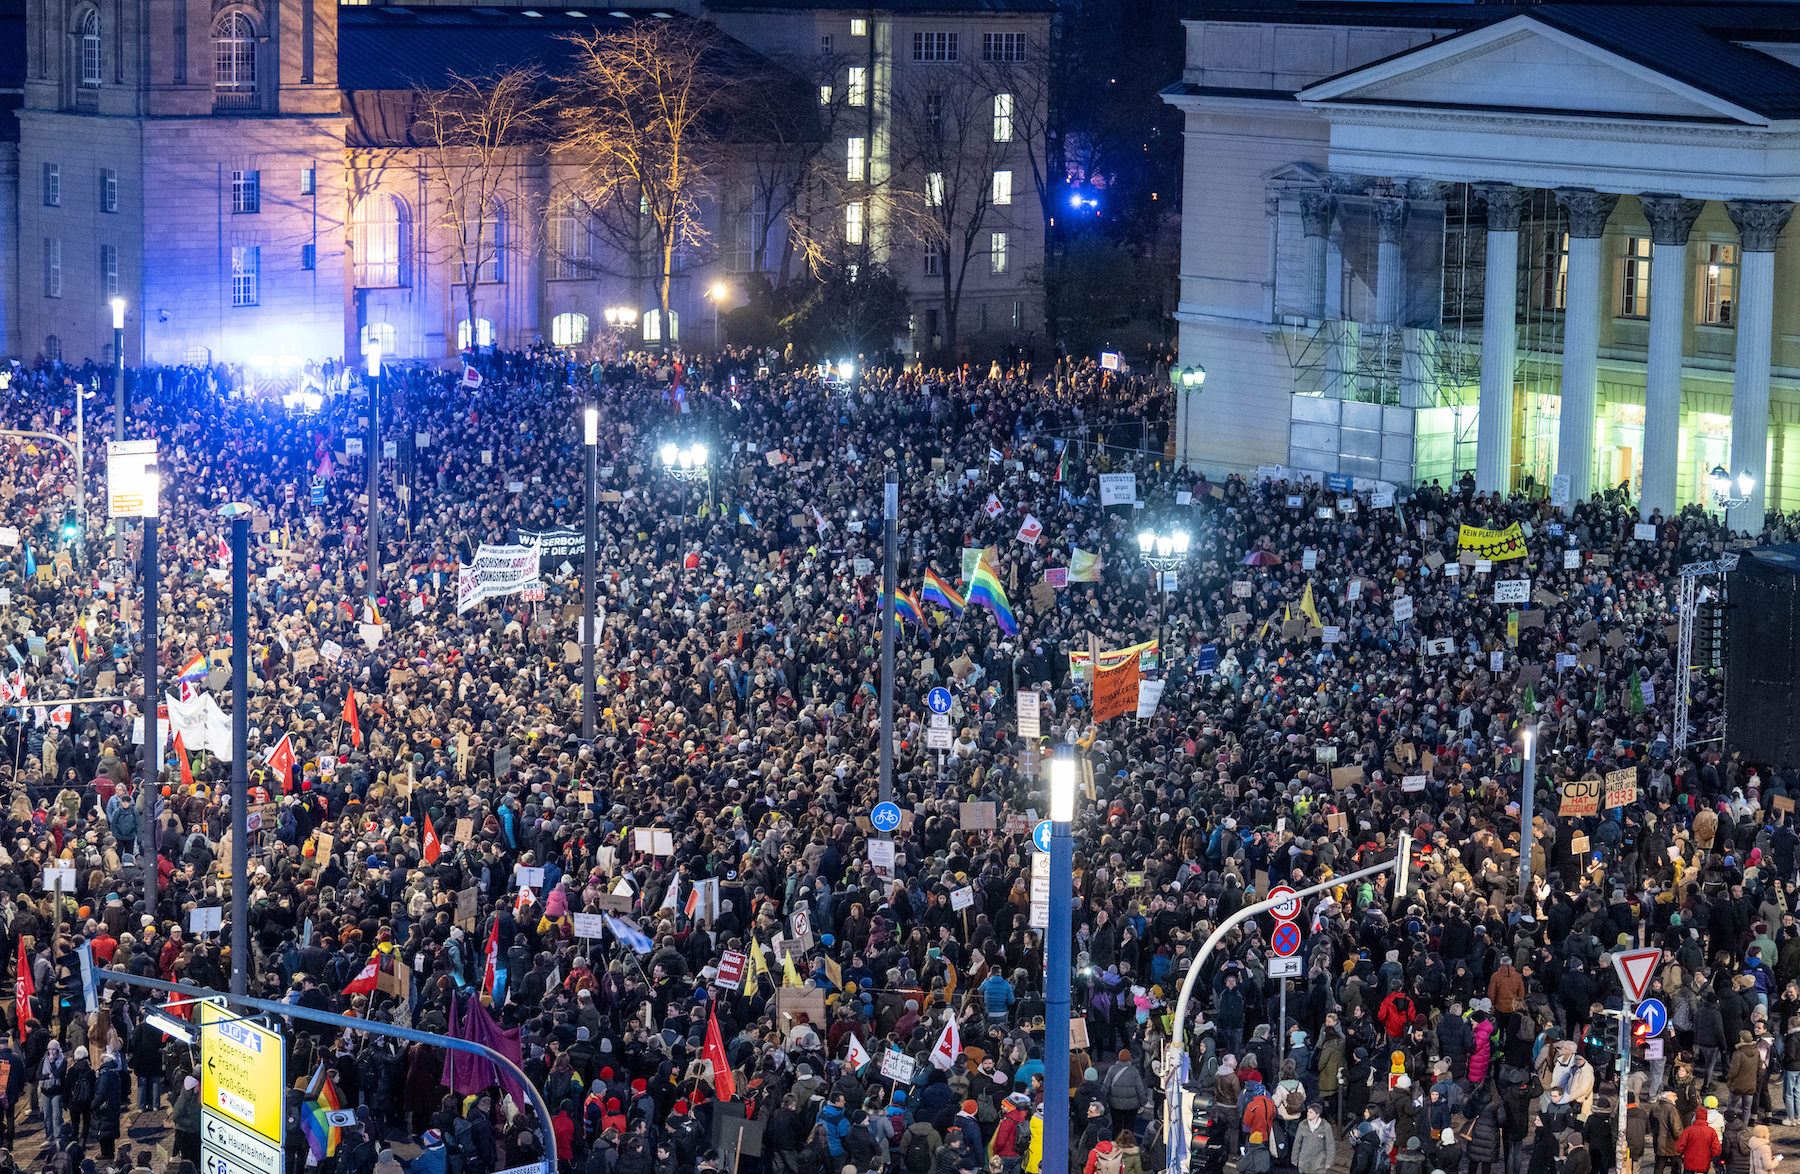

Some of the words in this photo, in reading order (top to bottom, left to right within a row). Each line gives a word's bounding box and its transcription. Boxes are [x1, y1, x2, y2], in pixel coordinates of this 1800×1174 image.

[551, 547, 567, 556] DIE
[1563, 782, 1600, 798] CDU
[1607, 788, 1633, 806] 1933
[1571, 796, 1588, 804] HAT
[724, 953, 741, 964] Nazis
[721, 963, 739, 974] töten.
[218, 1038, 255, 1066] Oppenheim
[218, 1055, 249, 1080] Frankfurt
[218, 1072, 257, 1101] Groß-Gerau
[228, 1097, 254, 1118] Klinikum
[228, 1132, 275, 1168] Hauptbahnhof
